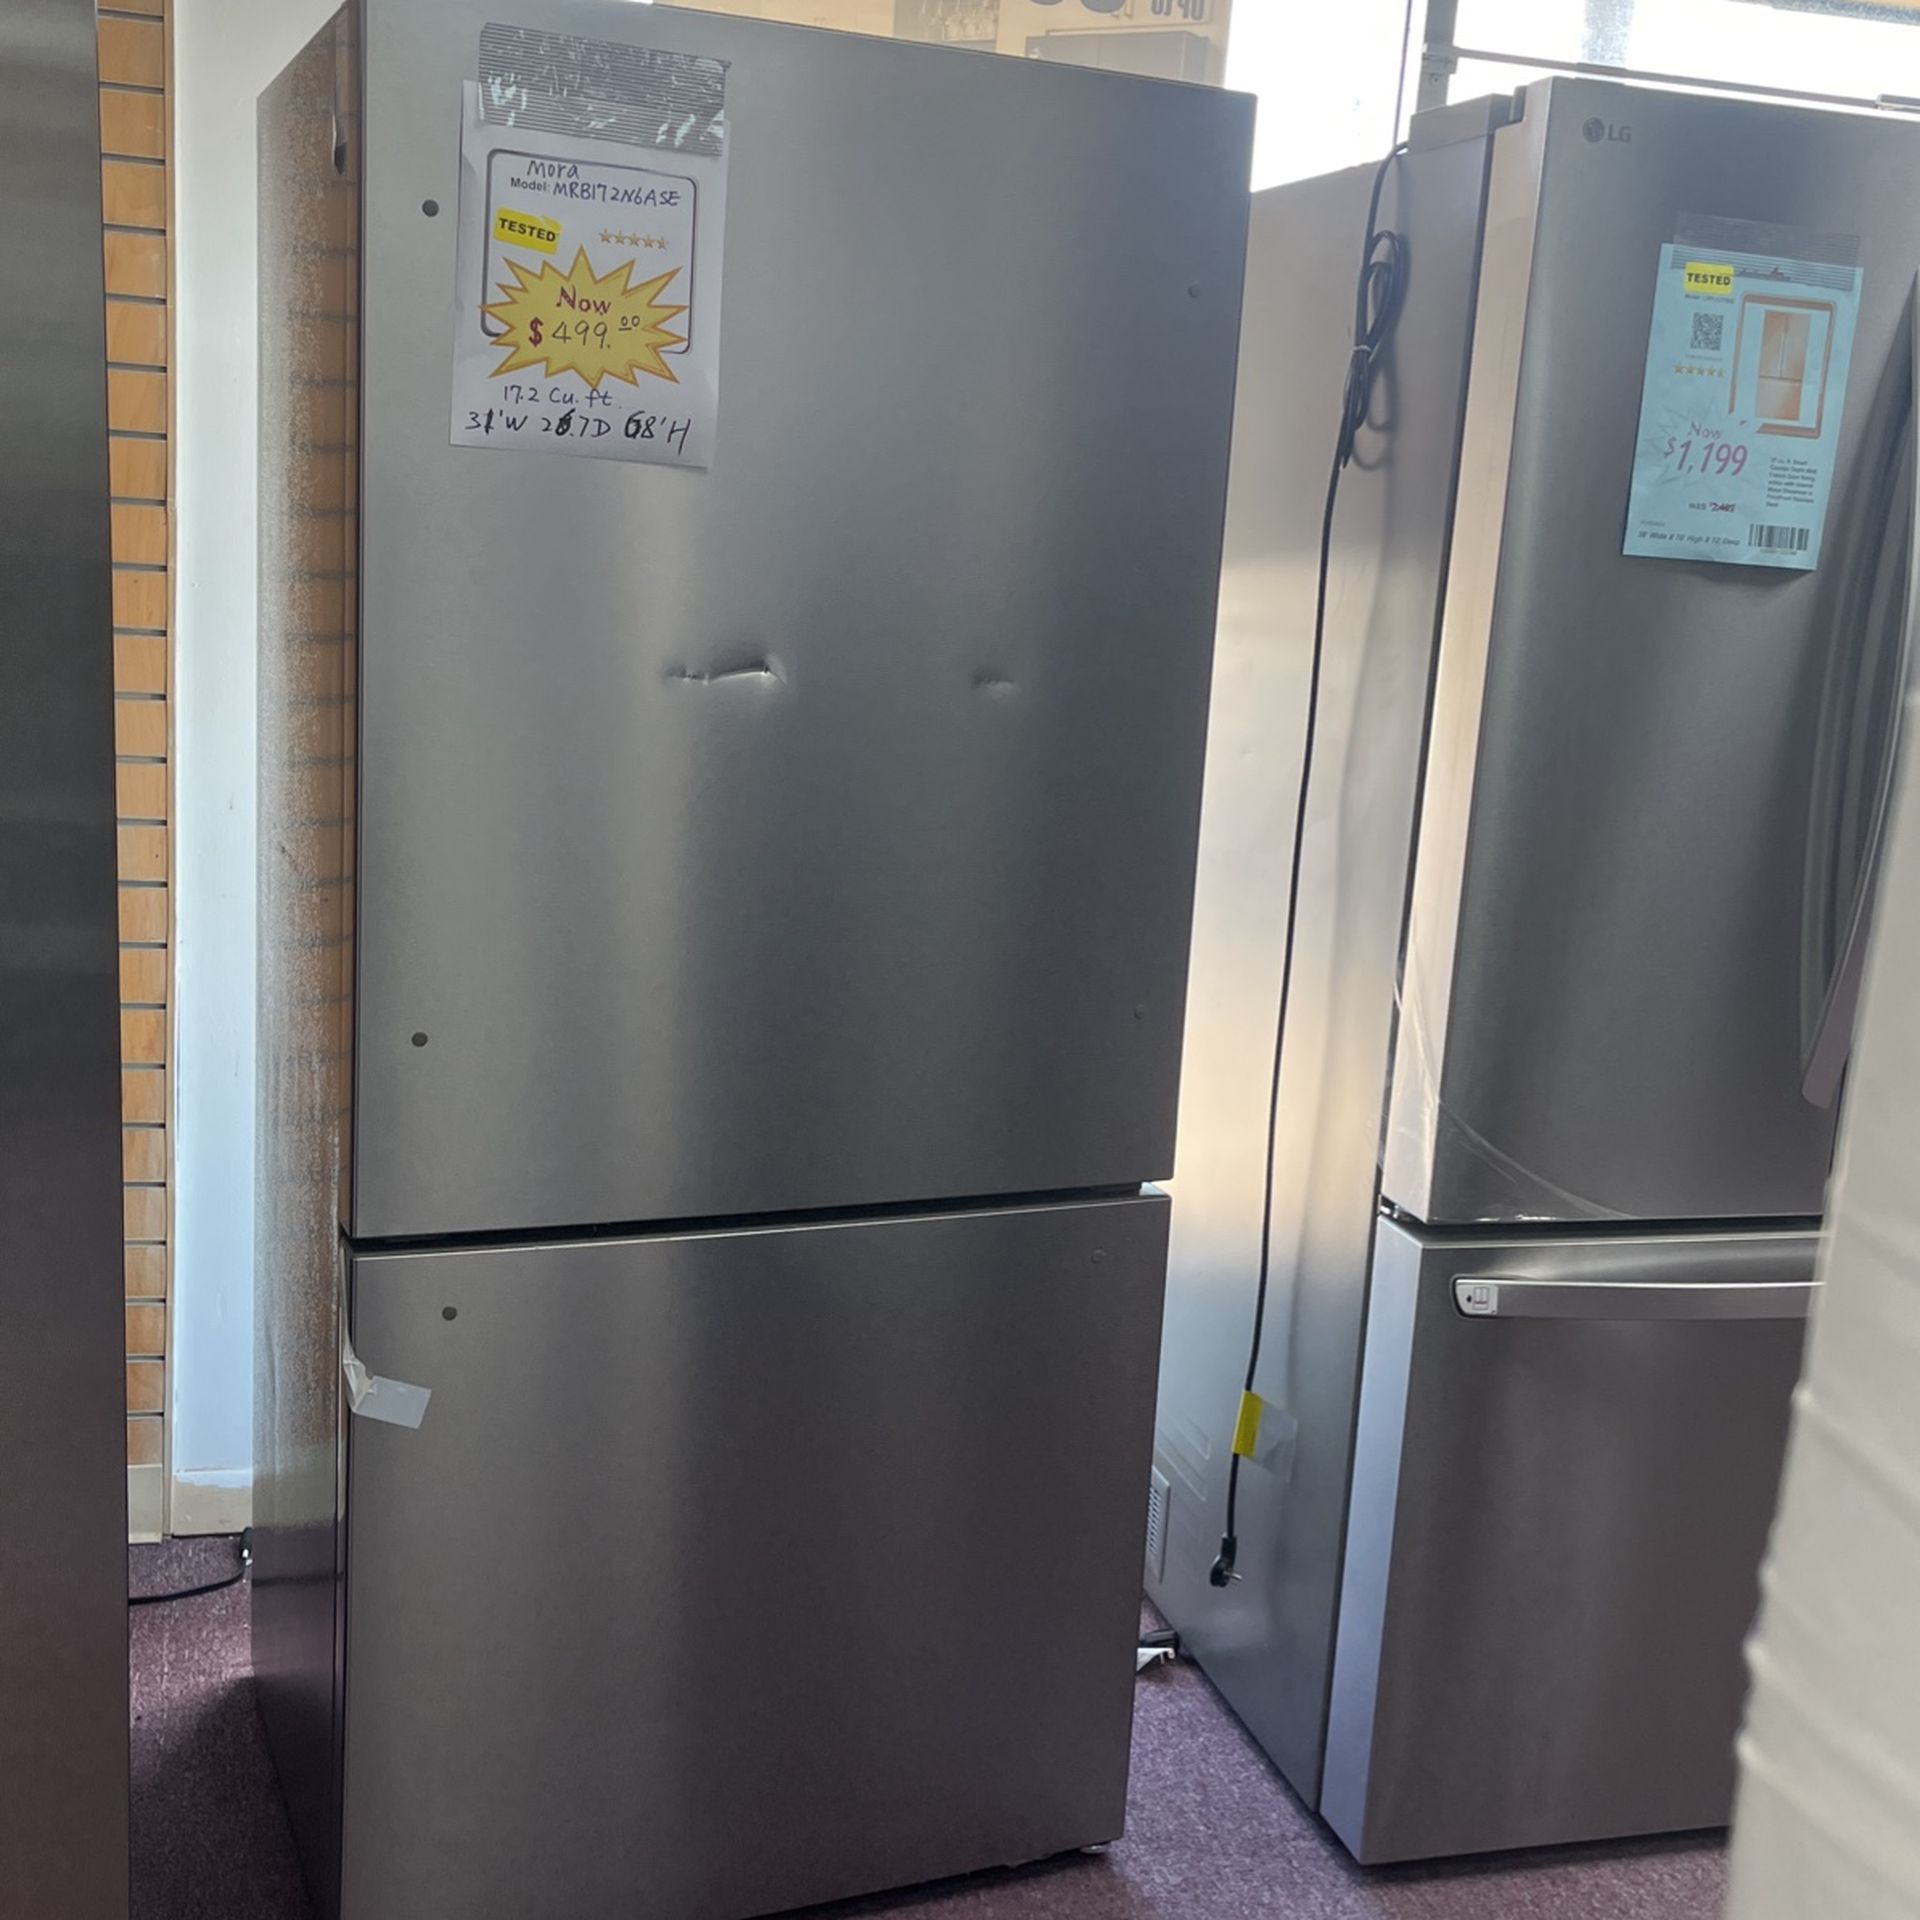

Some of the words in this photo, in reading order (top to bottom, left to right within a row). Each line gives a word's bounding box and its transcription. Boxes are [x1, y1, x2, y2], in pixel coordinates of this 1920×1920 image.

[1607, 123, 1632, 143] LG
[510, 177, 551, 193] Model:
[498, 217, 556, 243] TESTED
[1686, 272, 1731, 287] TESTED
[556, 286, 612, 316] Now
[503, 385, 540, 405] 17.2
[1688, 421, 1722, 440] Now
[1663, 437, 1748, 476] $1,199
